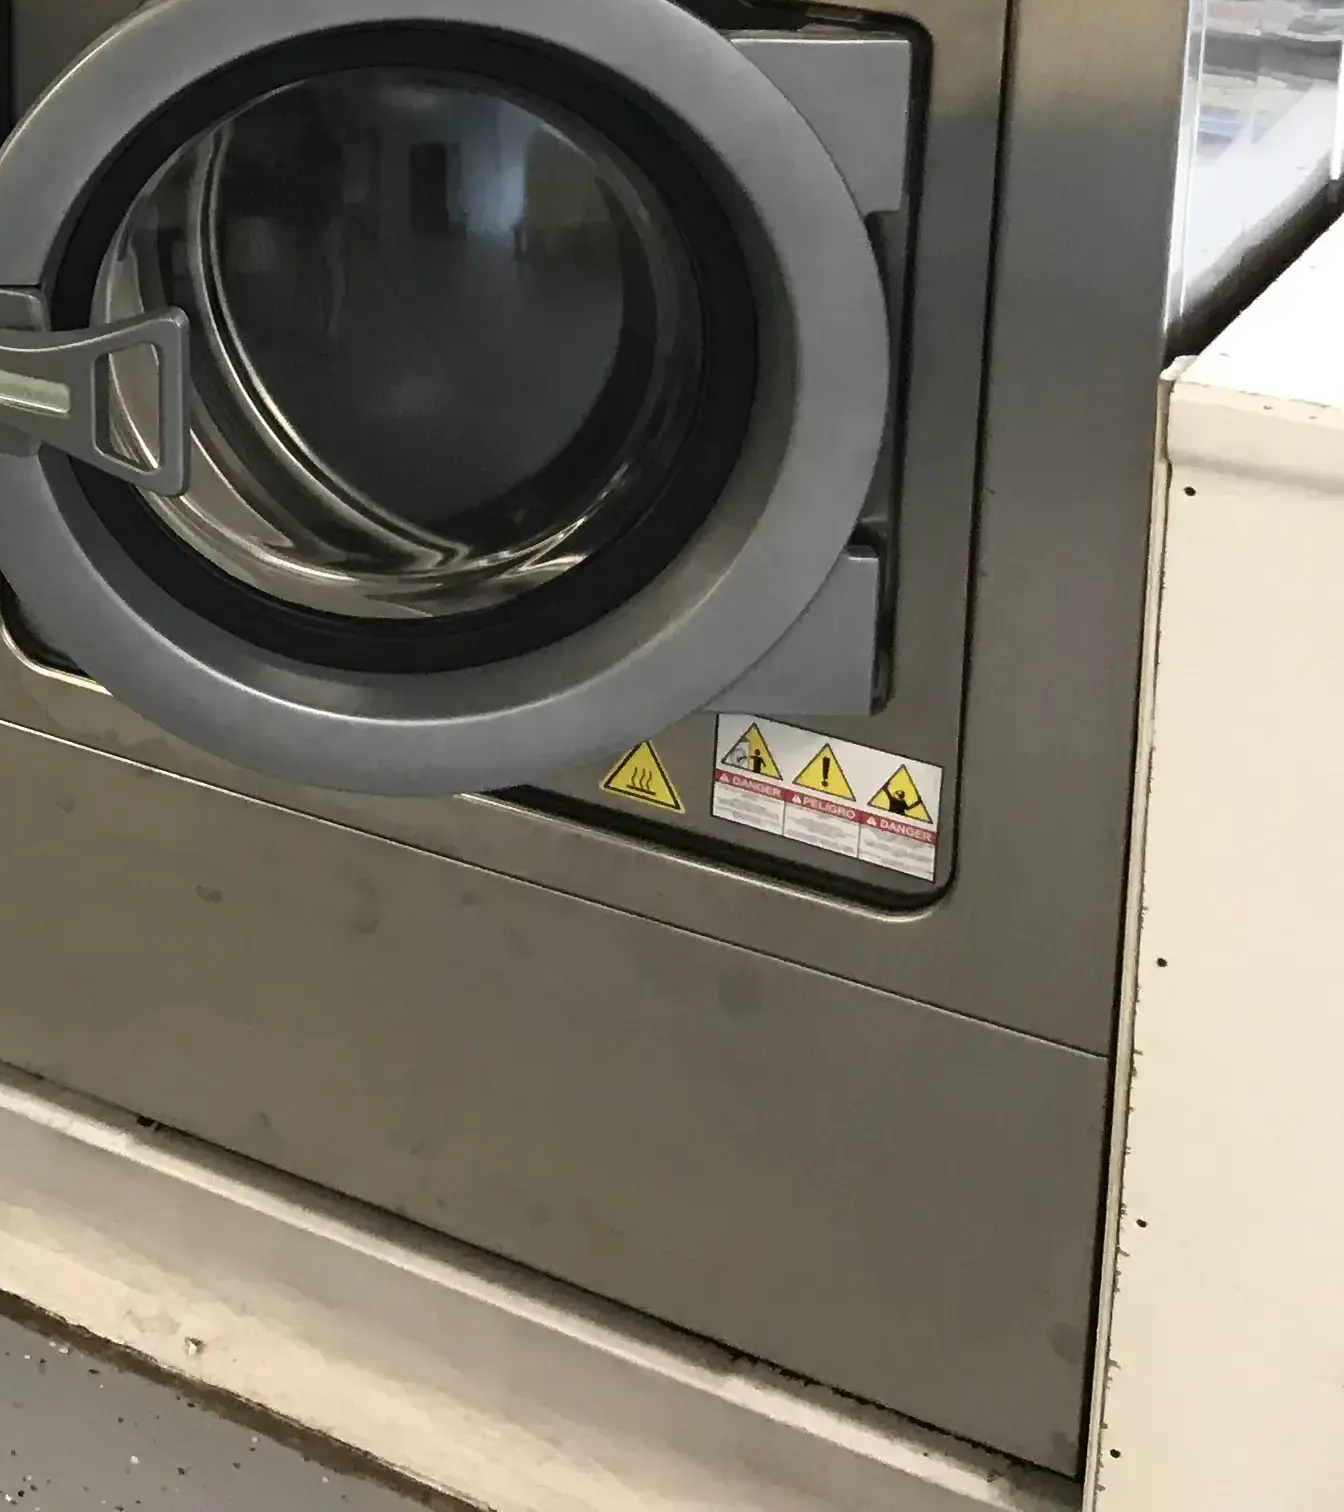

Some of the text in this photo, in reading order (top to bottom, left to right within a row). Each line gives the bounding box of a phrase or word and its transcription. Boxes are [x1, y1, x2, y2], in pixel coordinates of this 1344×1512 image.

[732, 776, 781, 798] DANGER
[803, 792, 857, 820] PELIGRO
[880, 819, 932, 843] DANGER
